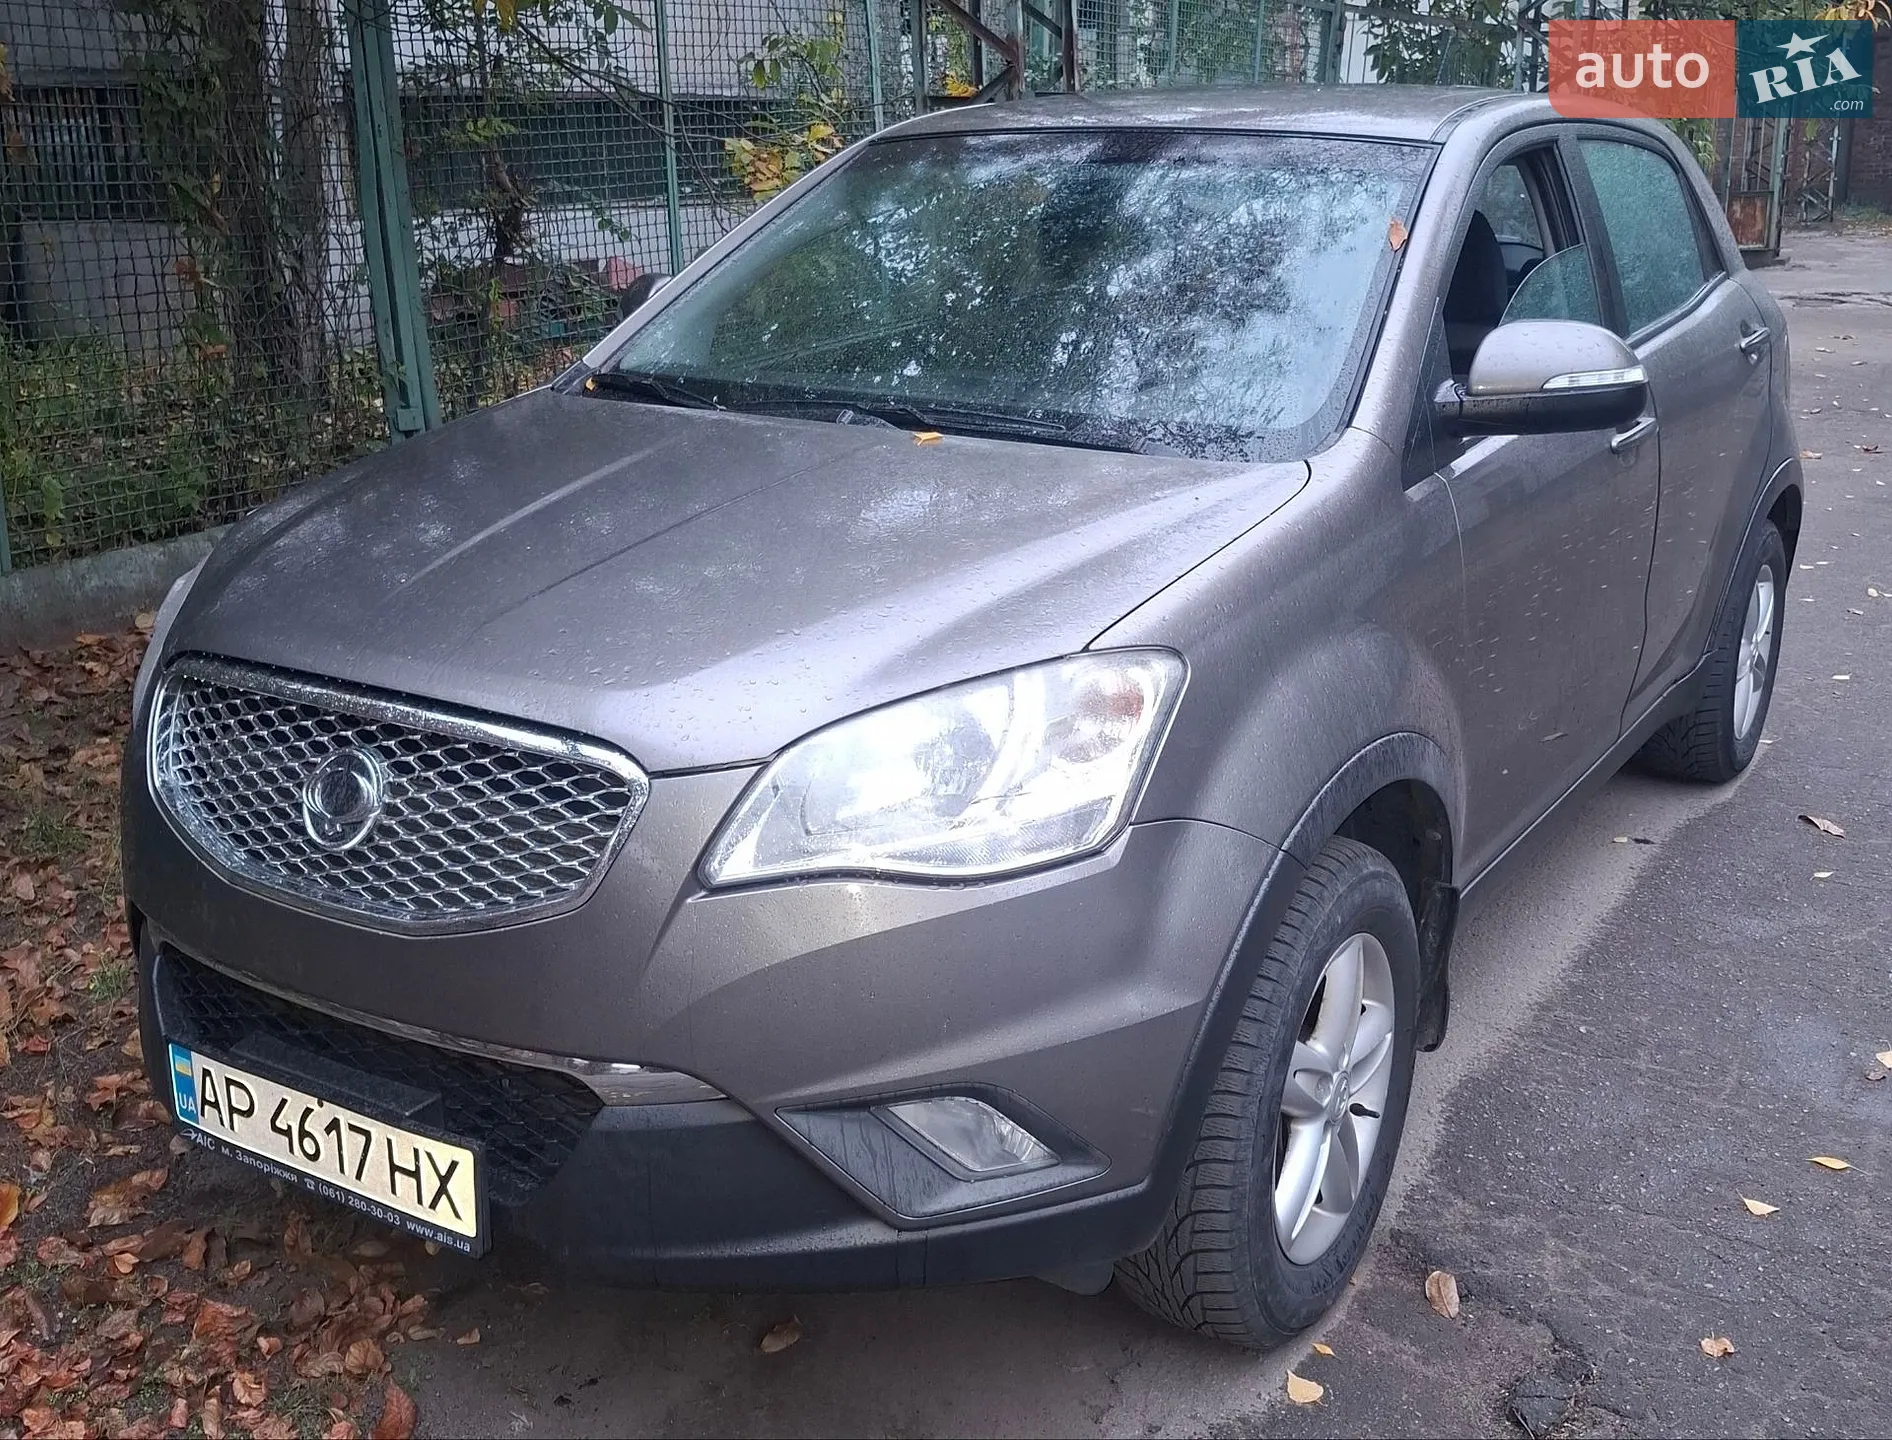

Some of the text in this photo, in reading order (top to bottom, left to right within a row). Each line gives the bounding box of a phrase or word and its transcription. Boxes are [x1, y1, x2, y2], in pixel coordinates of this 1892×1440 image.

[179, 1092, 197, 1116] UA
[200, 1067, 463, 1221] AP 4617 HX
[318, 1182, 346, 1204] (061)
[347, 1195, 401, 1226] 280-30-03
[406, 1220, 471, 1253] www.ais.ua
